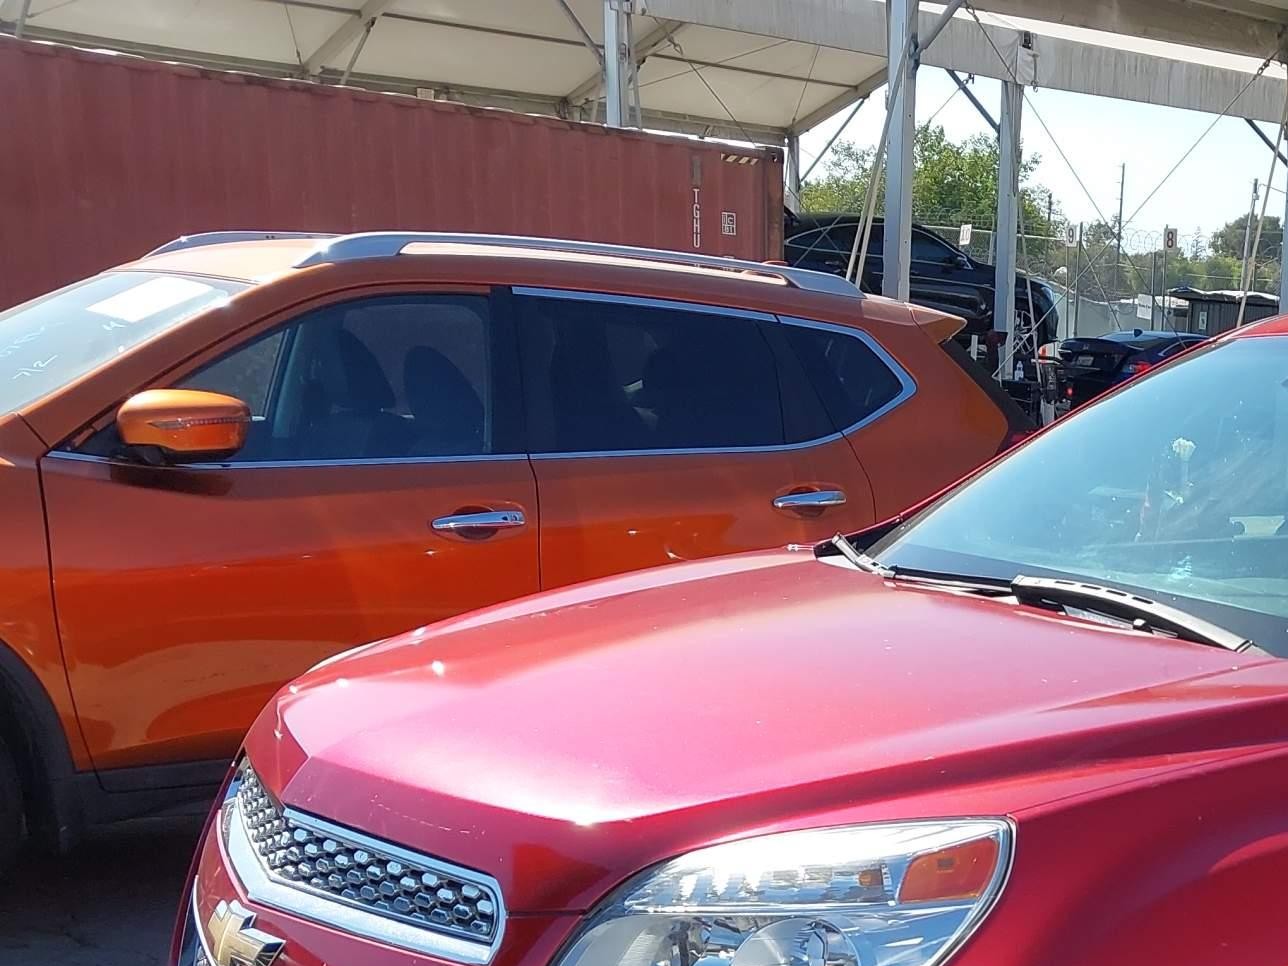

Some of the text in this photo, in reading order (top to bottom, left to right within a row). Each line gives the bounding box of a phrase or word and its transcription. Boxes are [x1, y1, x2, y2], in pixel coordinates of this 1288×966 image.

[692, 188, 701, 248] TGHU
[1068, 229, 1075, 244] 9
[1166, 231, 1174, 249] 8
